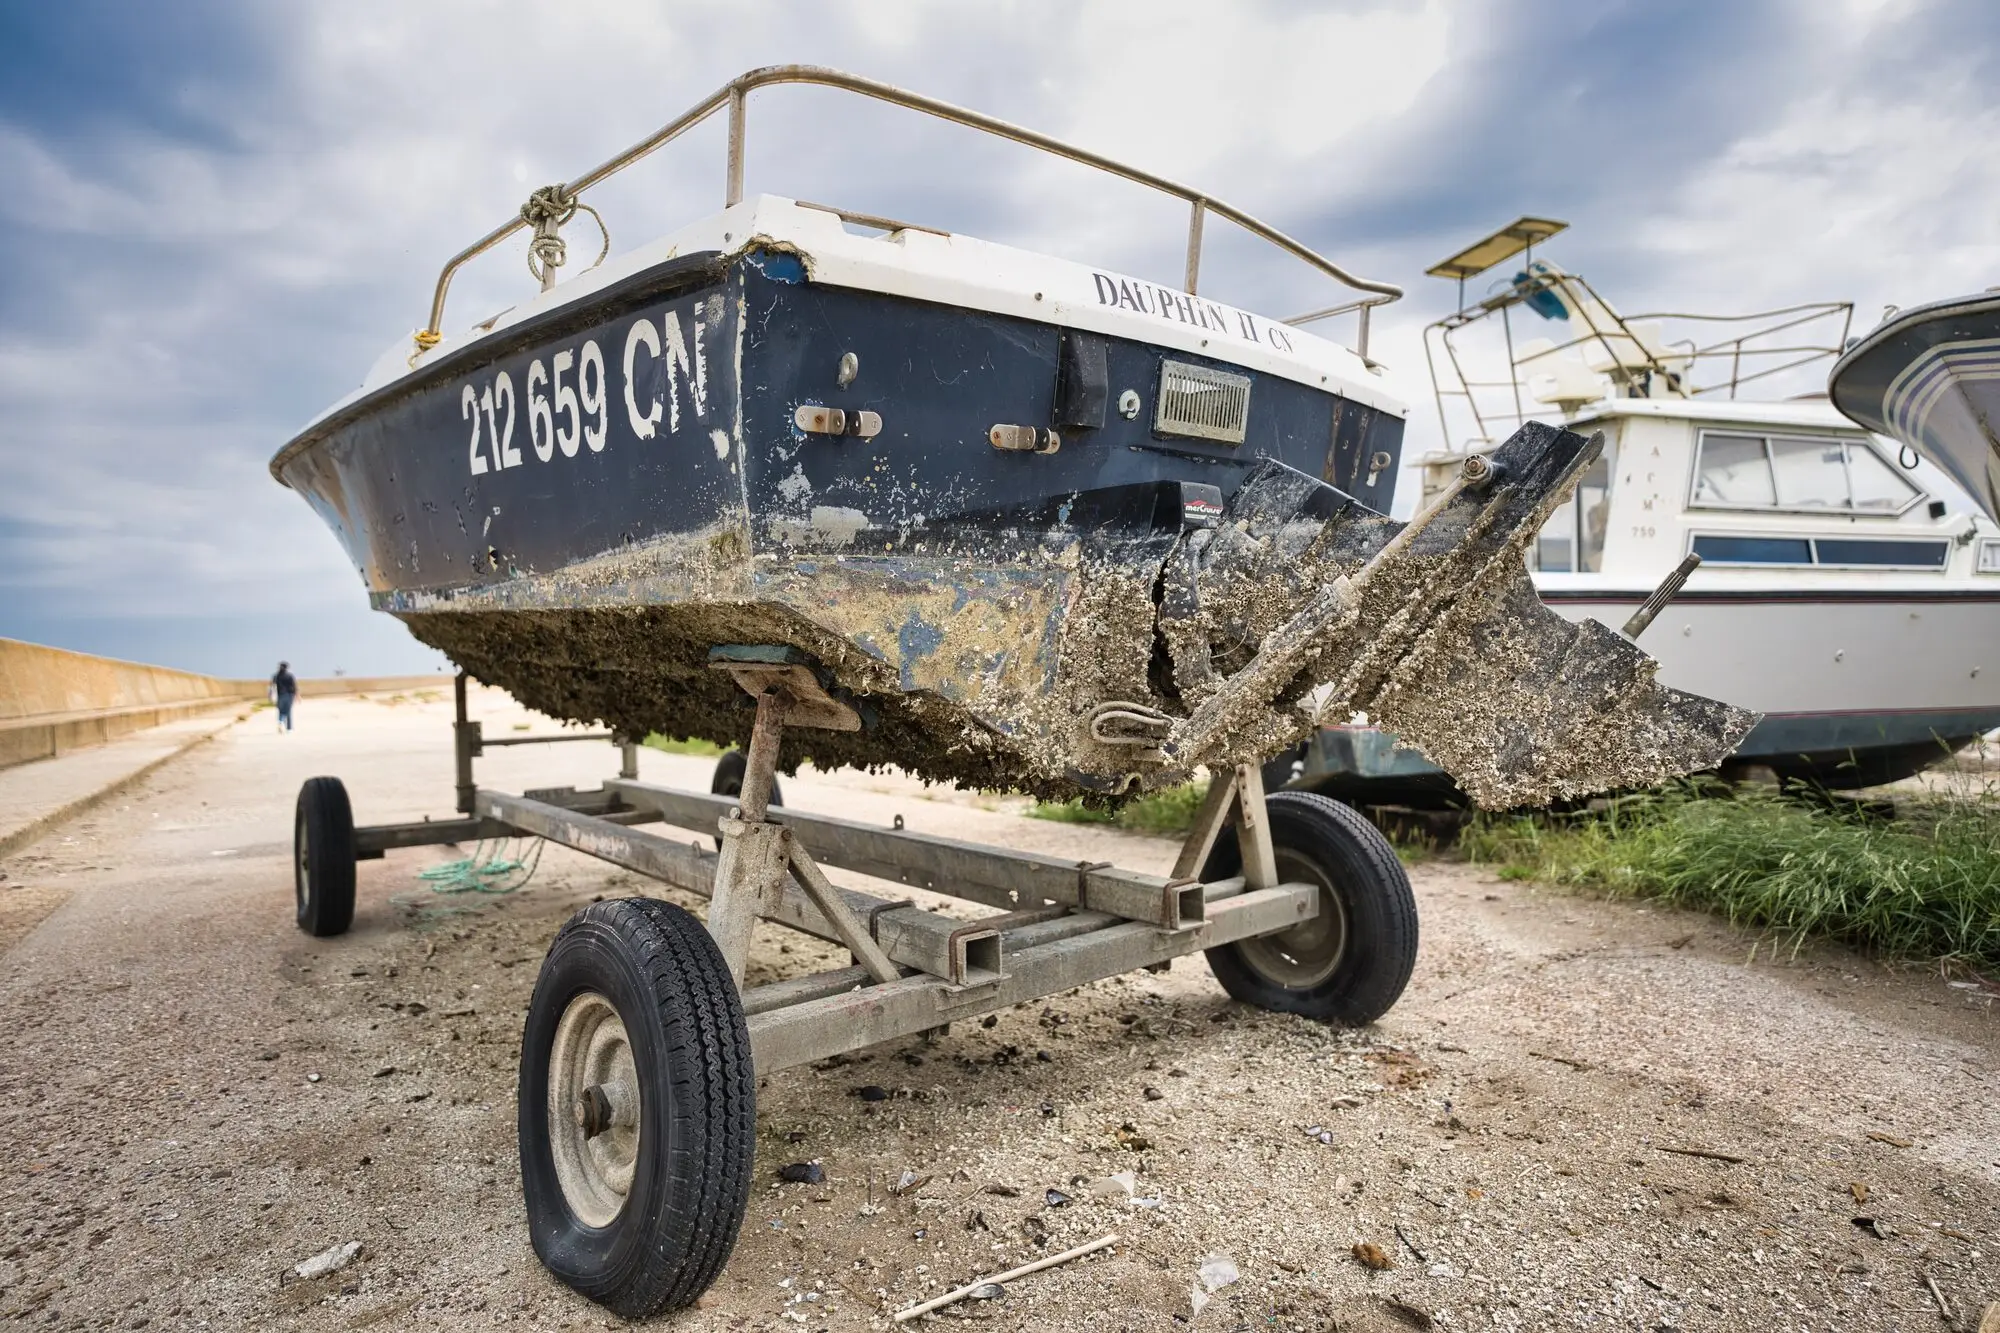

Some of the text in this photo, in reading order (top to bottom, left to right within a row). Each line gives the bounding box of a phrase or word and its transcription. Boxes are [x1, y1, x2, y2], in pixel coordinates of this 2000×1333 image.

[1092, 273, 1228, 334] DAUPHIN
[1236, 311, 1261, 343] II
[462, 301, 708, 475] 212 659 CN
